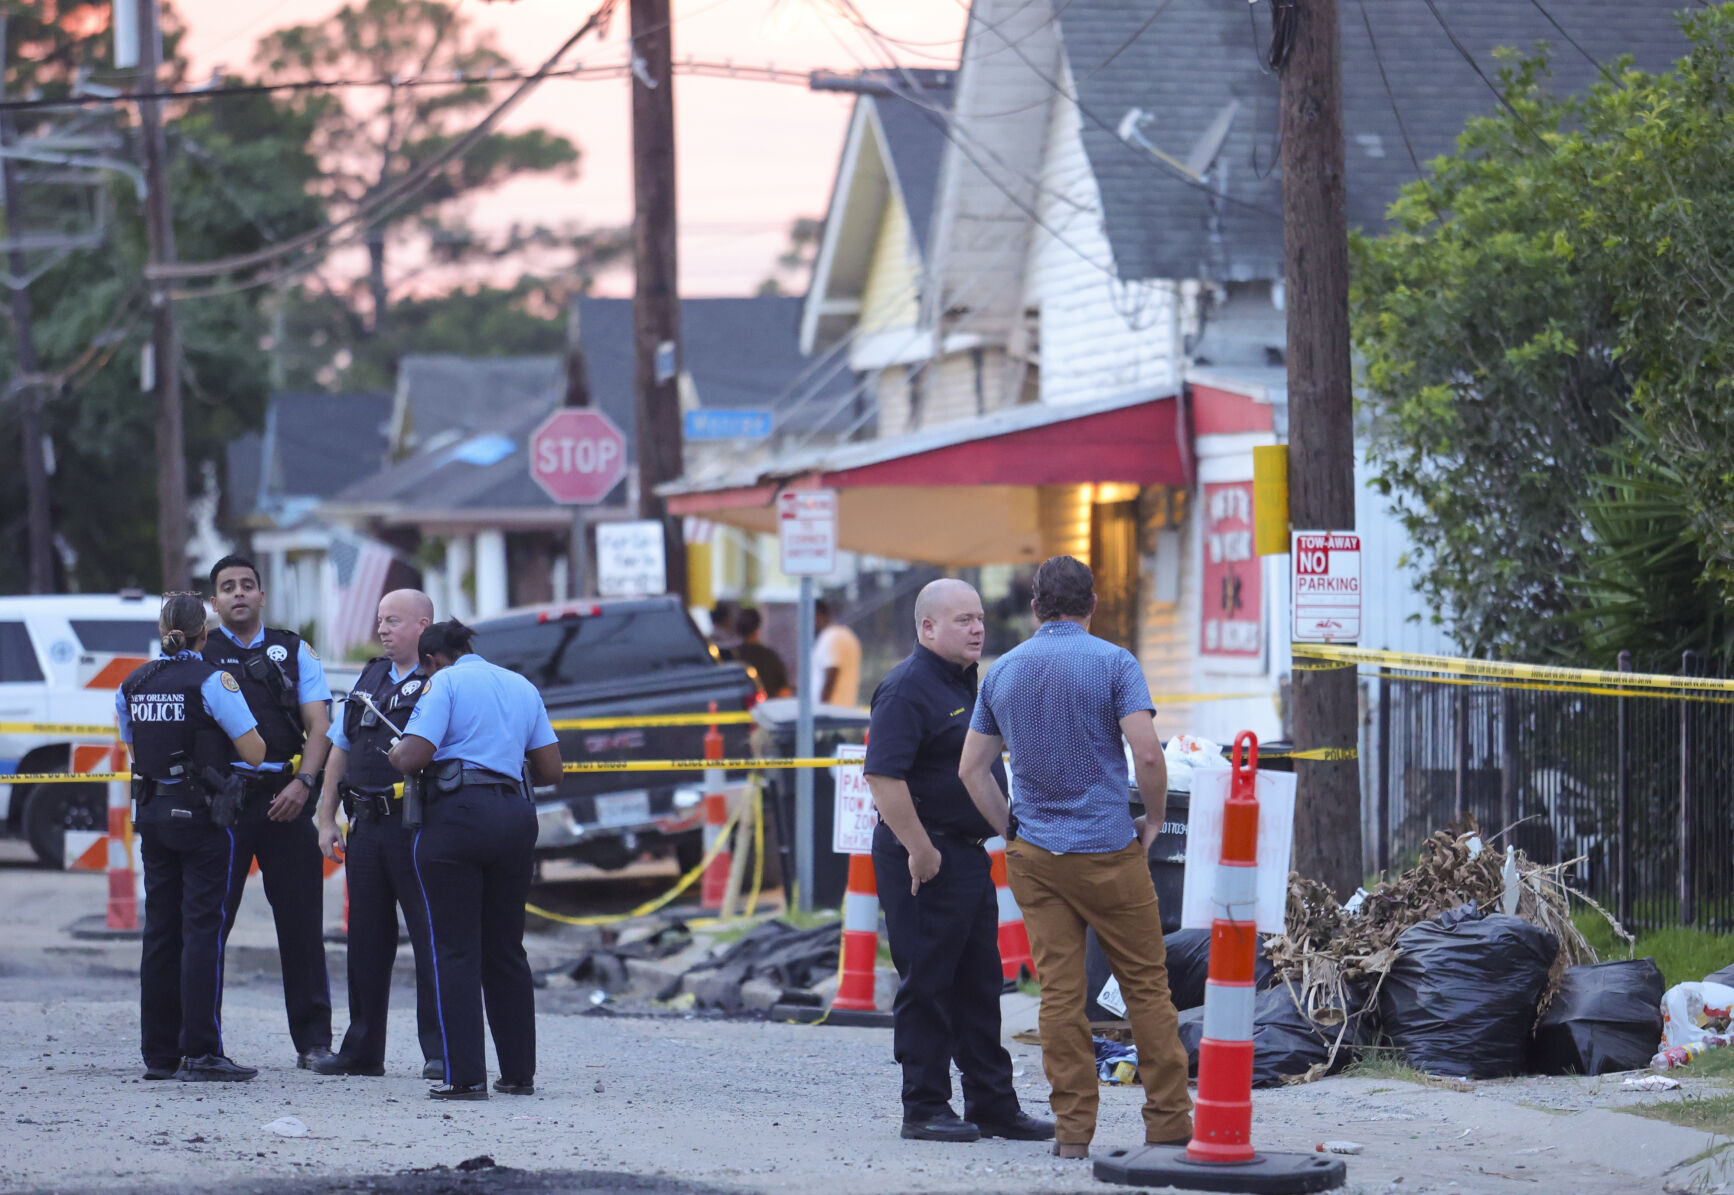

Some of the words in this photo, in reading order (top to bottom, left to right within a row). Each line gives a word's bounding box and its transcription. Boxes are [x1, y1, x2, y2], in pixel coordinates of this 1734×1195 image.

[538, 437, 618, 474] STOP
[1300, 536, 1358, 549] TOW-AWAY
[1300, 551, 1327, 573] NO
[1298, 578, 1359, 592] PARKING
[131, 693, 145, 703] NEW
[146, 693, 185, 702] ORLEANS
[131, 703, 186, 722] POLICE
[843, 796, 865, 812] TOW
[854, 813, 878, 830] ZON
